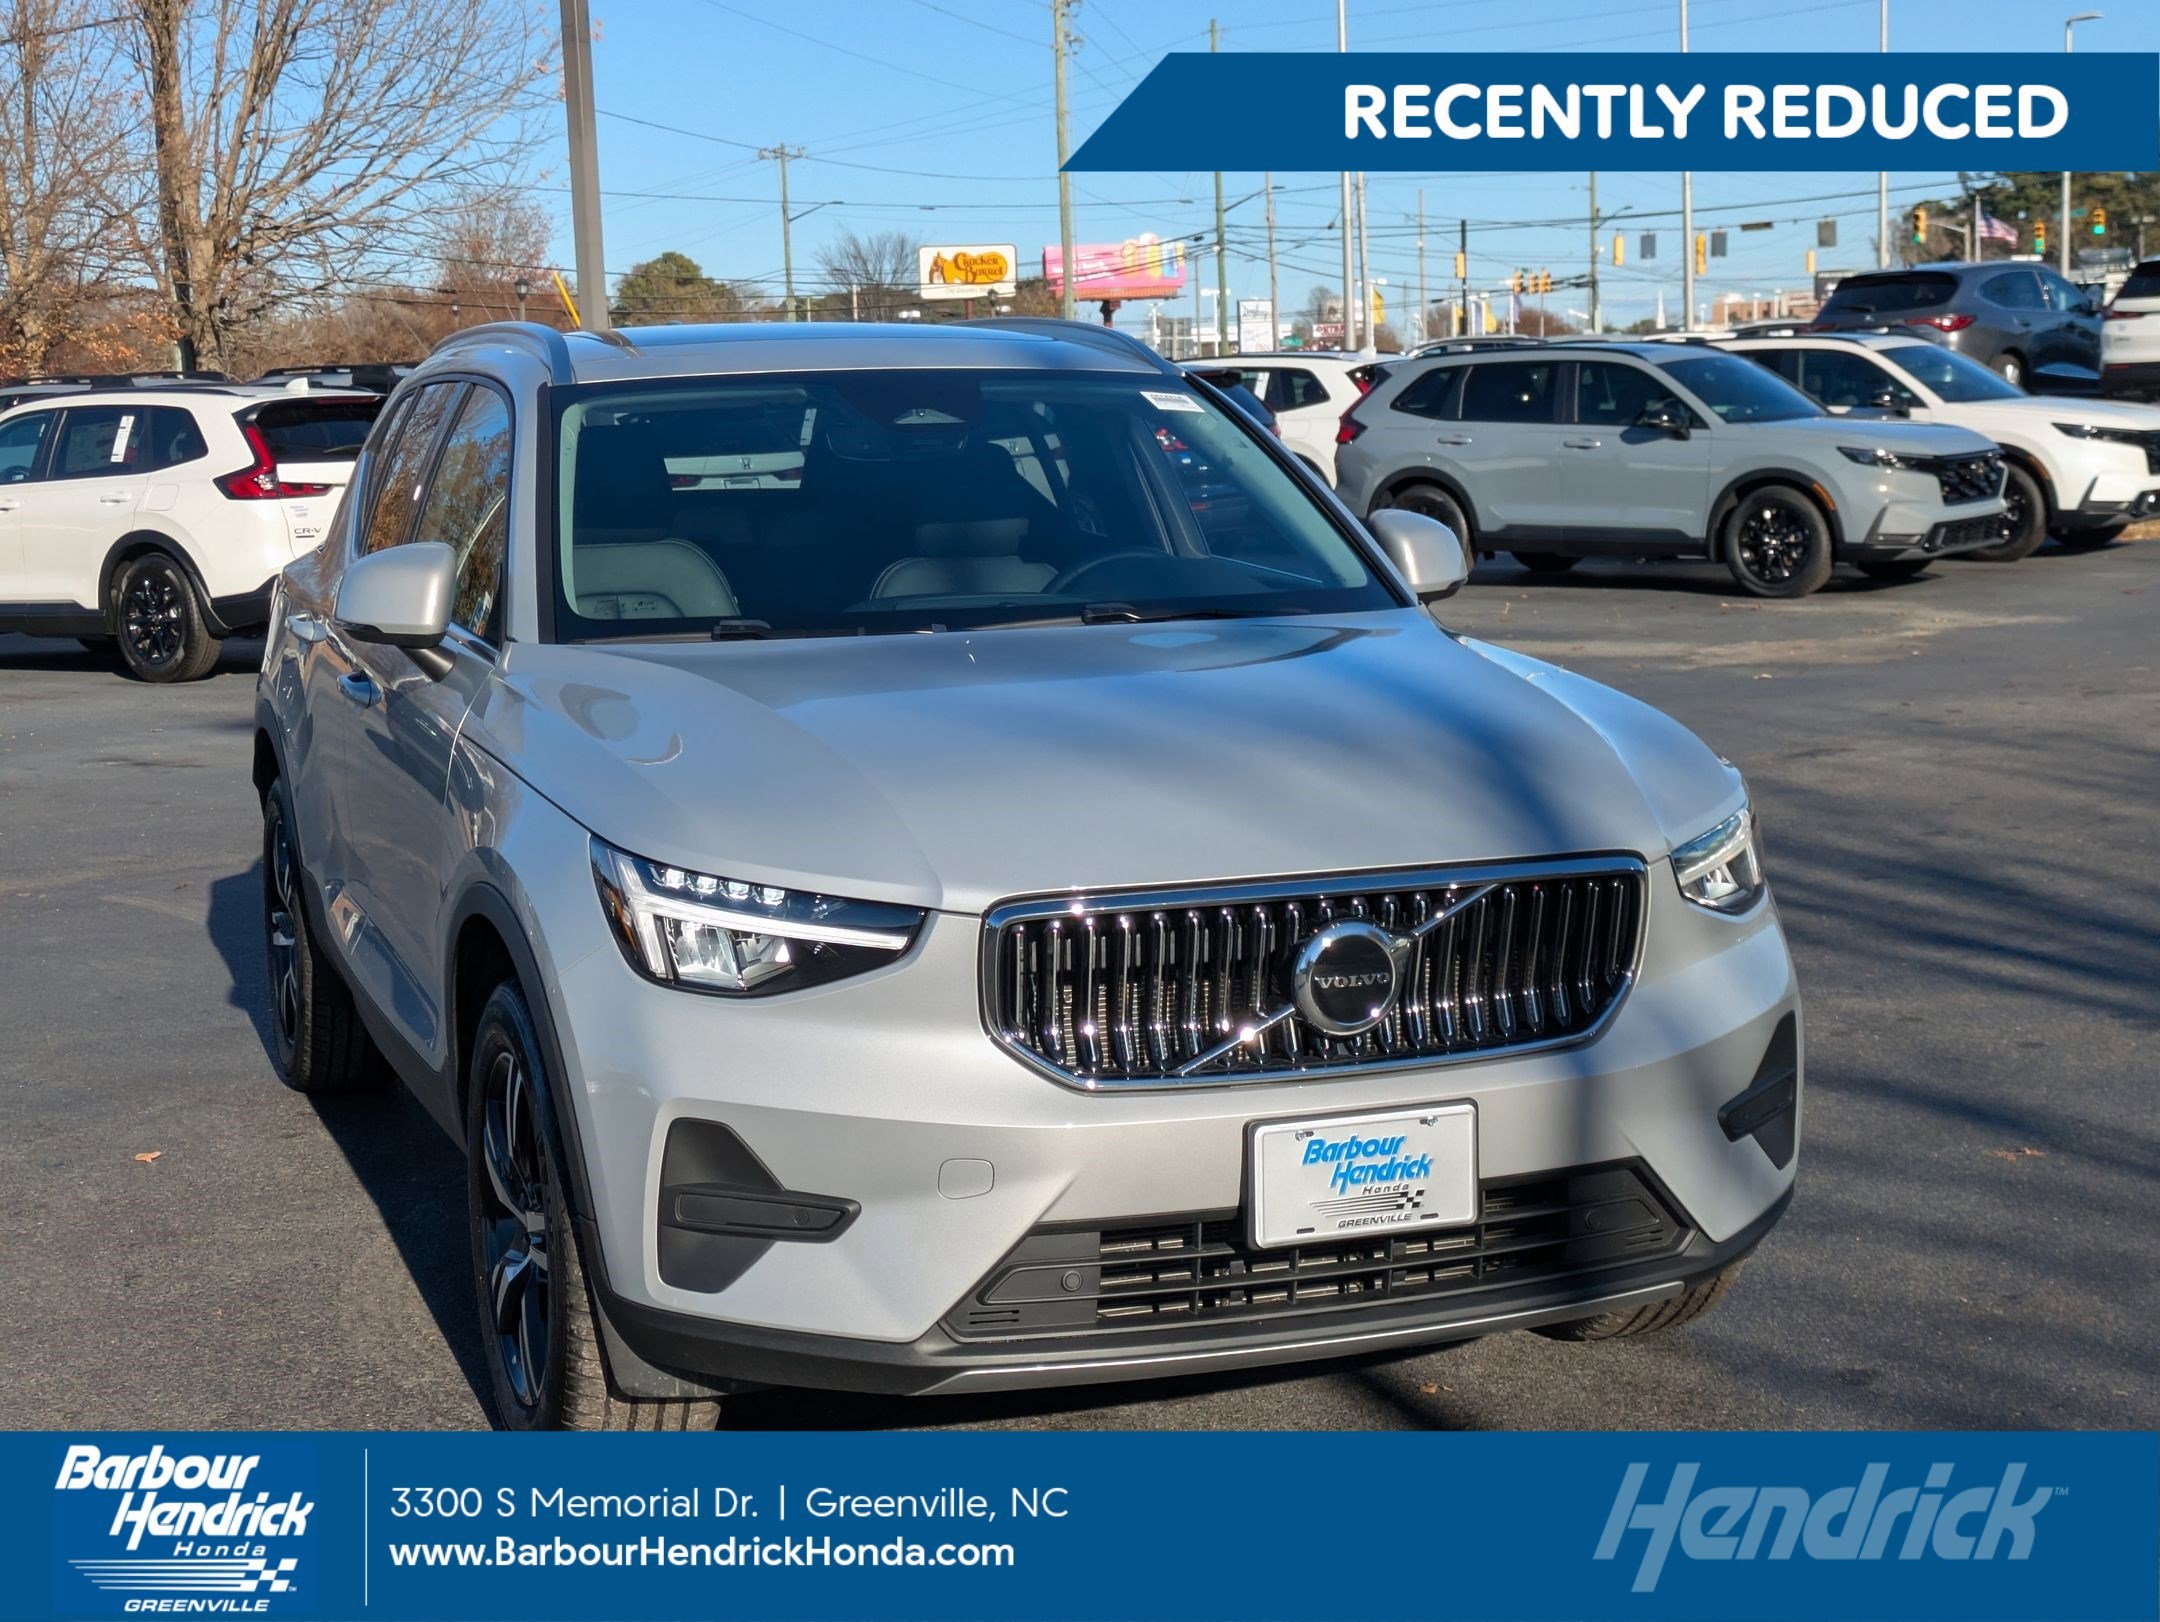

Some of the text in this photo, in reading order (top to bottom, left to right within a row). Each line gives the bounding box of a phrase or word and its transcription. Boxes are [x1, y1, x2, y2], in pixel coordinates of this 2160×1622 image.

[294, 527, 322, 535] CR-V
[1315, 972, 1391, 989] VOLVO
[1302, 1134, 1408, 1167] Barbour
[1329, 1152, 1435, 1195] Hendrick
[1362, 1183, 1410, 1196] Honda
[1338, 1213, 1412, 1228] GREENVILLE
